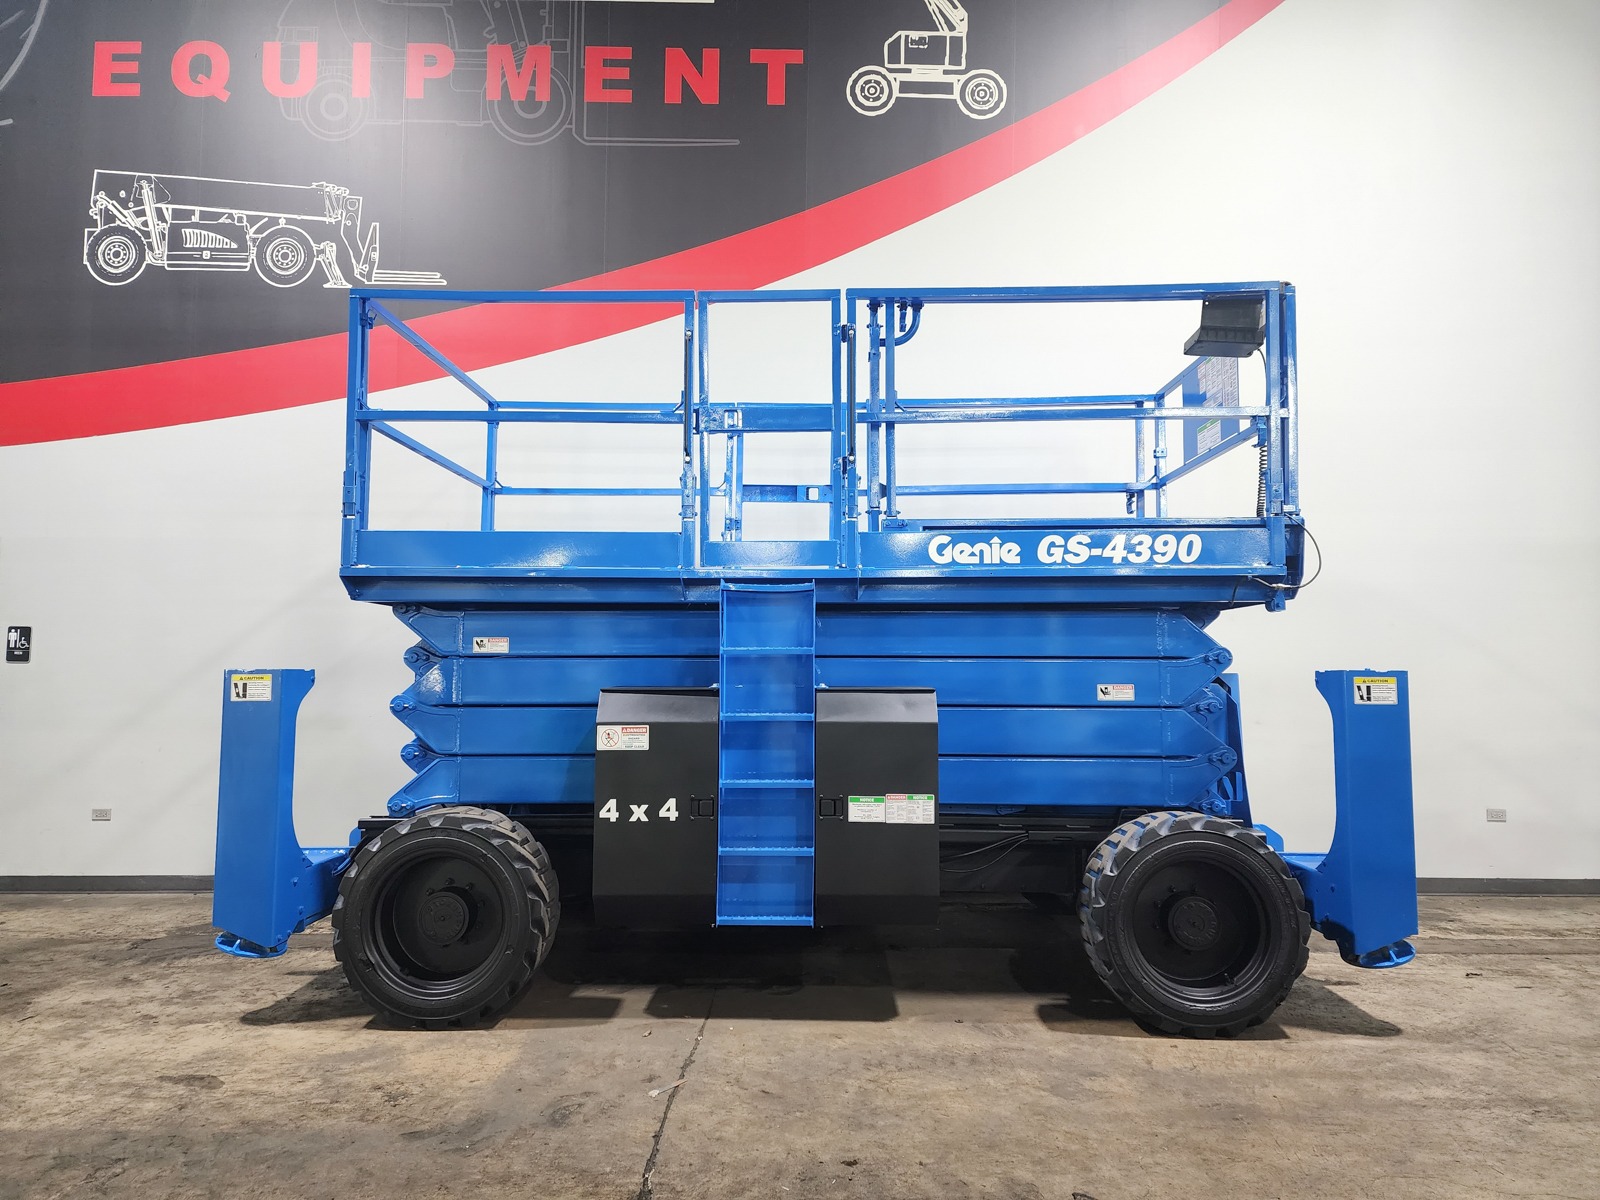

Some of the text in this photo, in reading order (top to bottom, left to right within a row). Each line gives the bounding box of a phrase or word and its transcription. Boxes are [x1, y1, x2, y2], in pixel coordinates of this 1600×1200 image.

[92, 41, 804, 106] EQUIPMENT
[928, 533, 1202, 564] Genie GS-4390
[599, 798, 679, 822] 4 x 4
